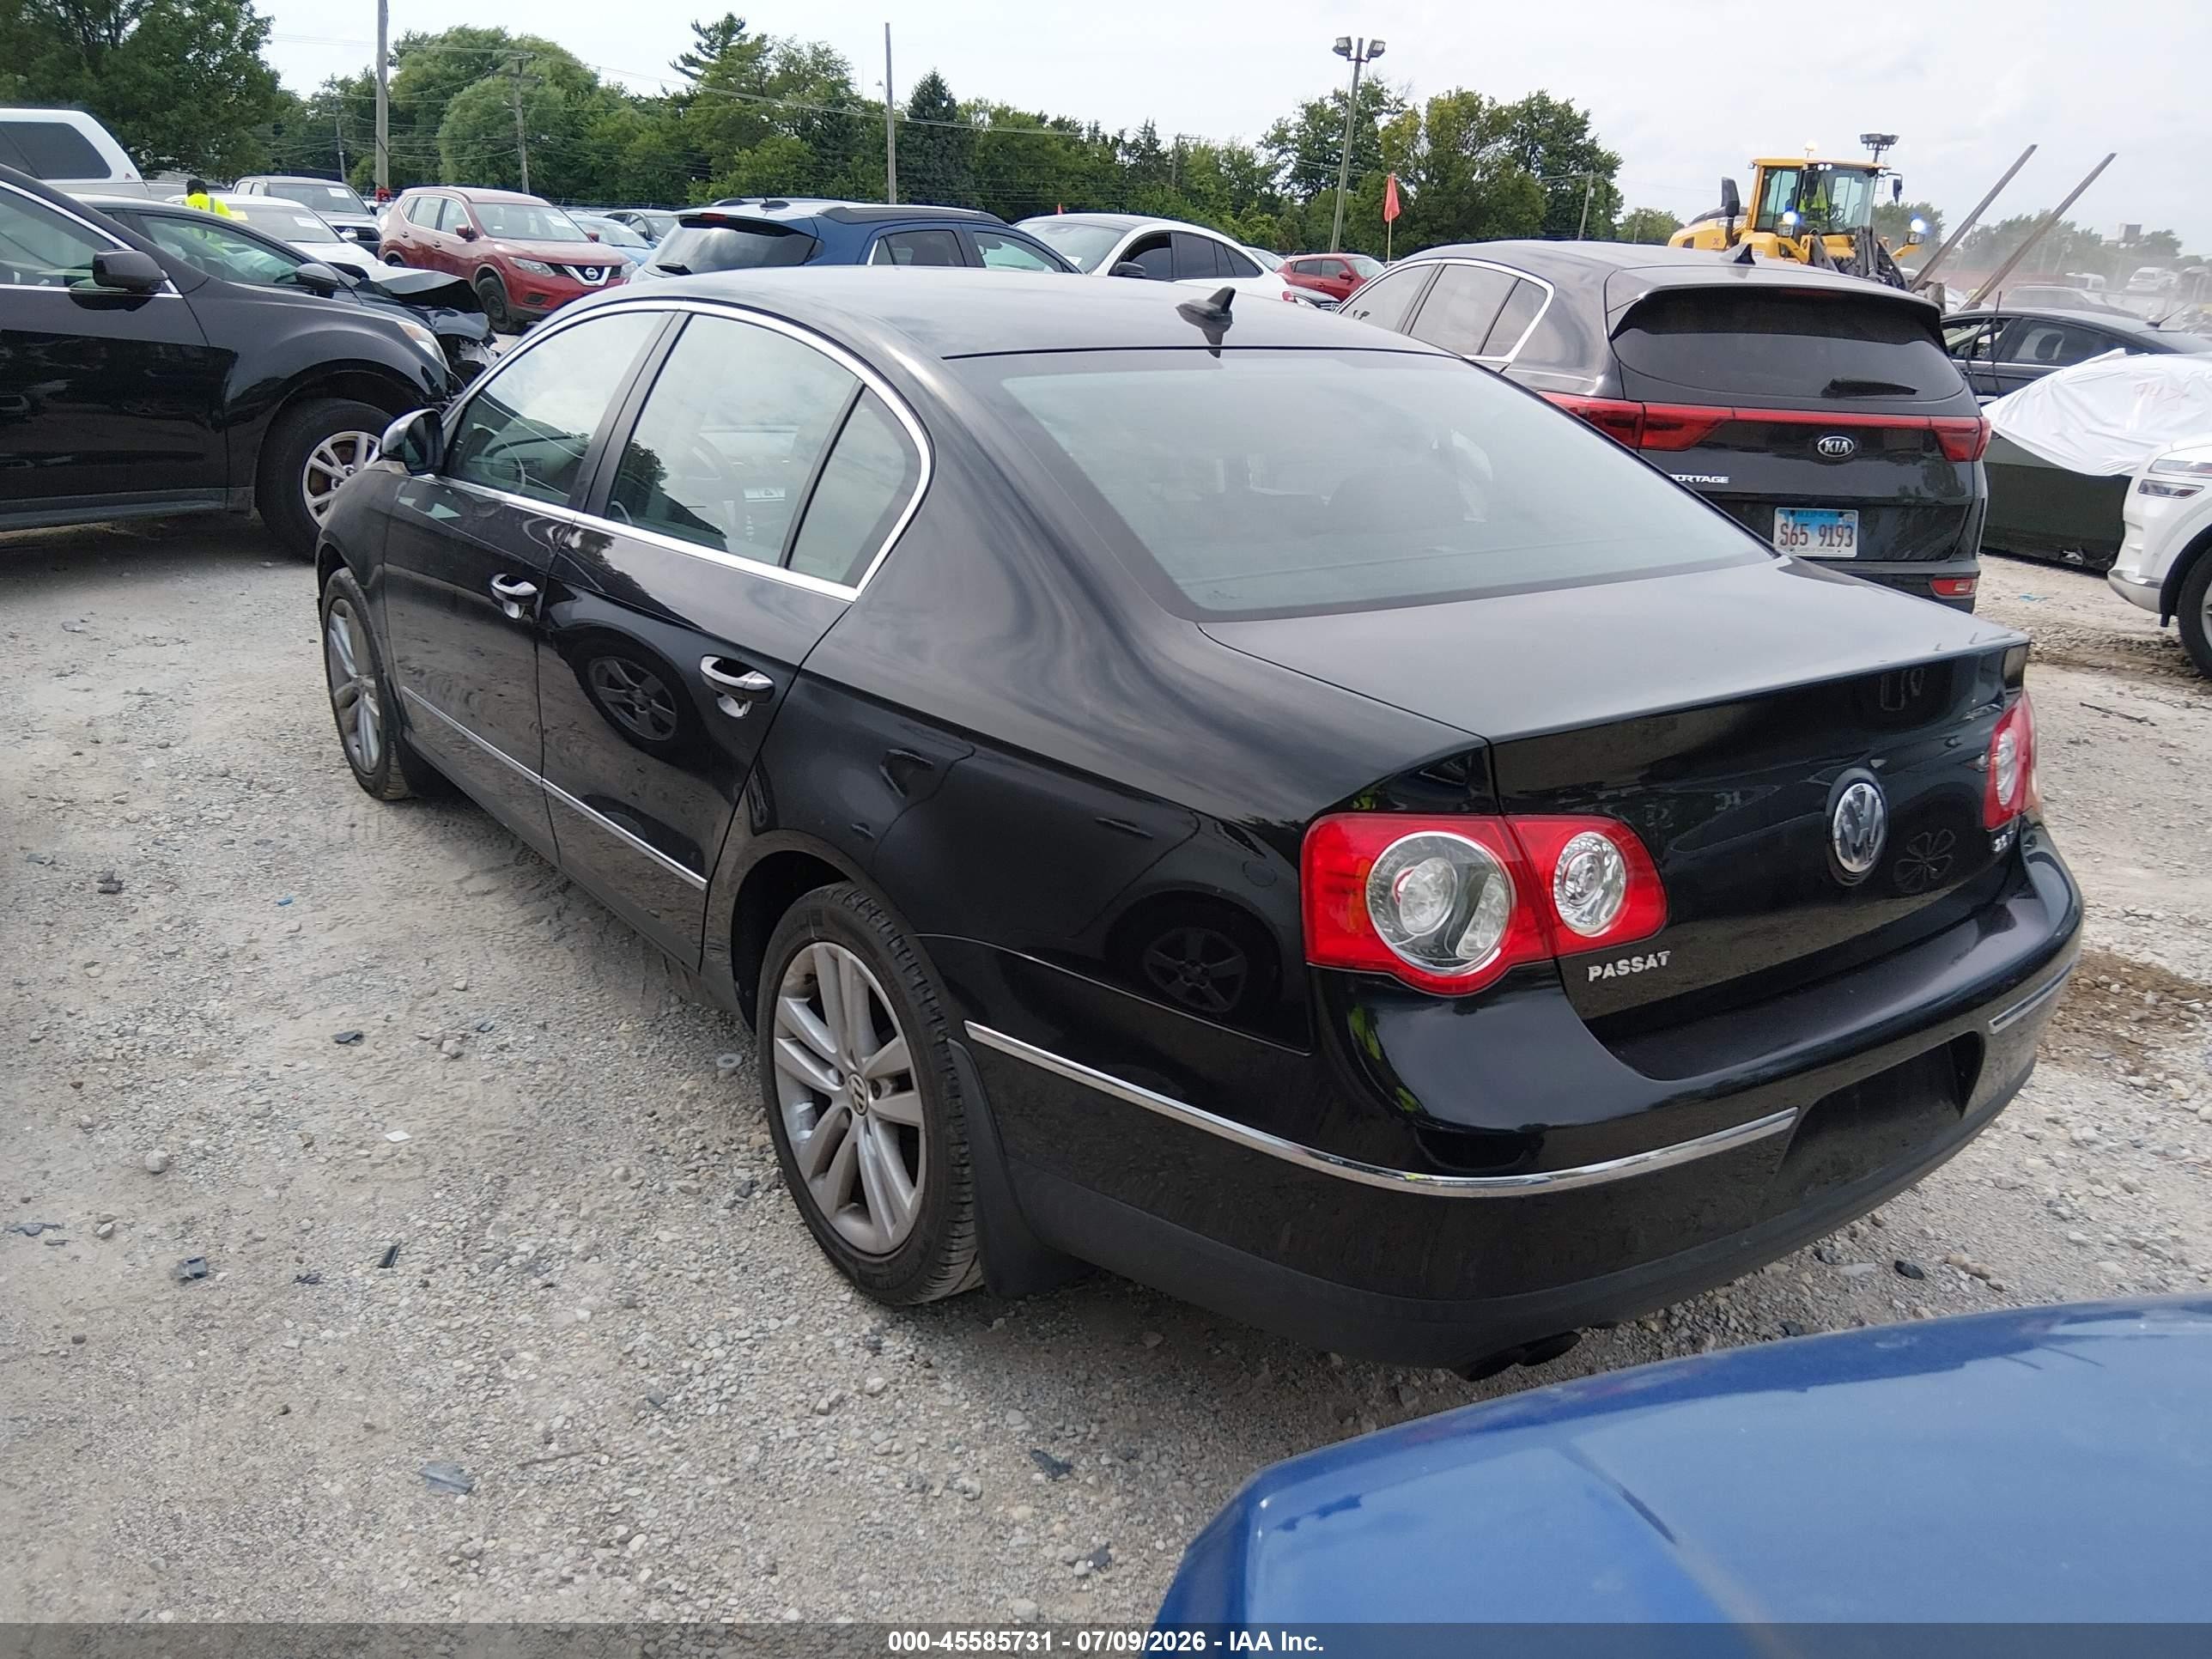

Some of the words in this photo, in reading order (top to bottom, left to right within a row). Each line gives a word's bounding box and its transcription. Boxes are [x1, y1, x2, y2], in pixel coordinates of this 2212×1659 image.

[1824, 440, 1849, 453] KIA
[1780, 522, 1809, 546] S65
[1819, 524, 1854, 548] 9193
[1587, 950, 1672, 982] PASSAT
